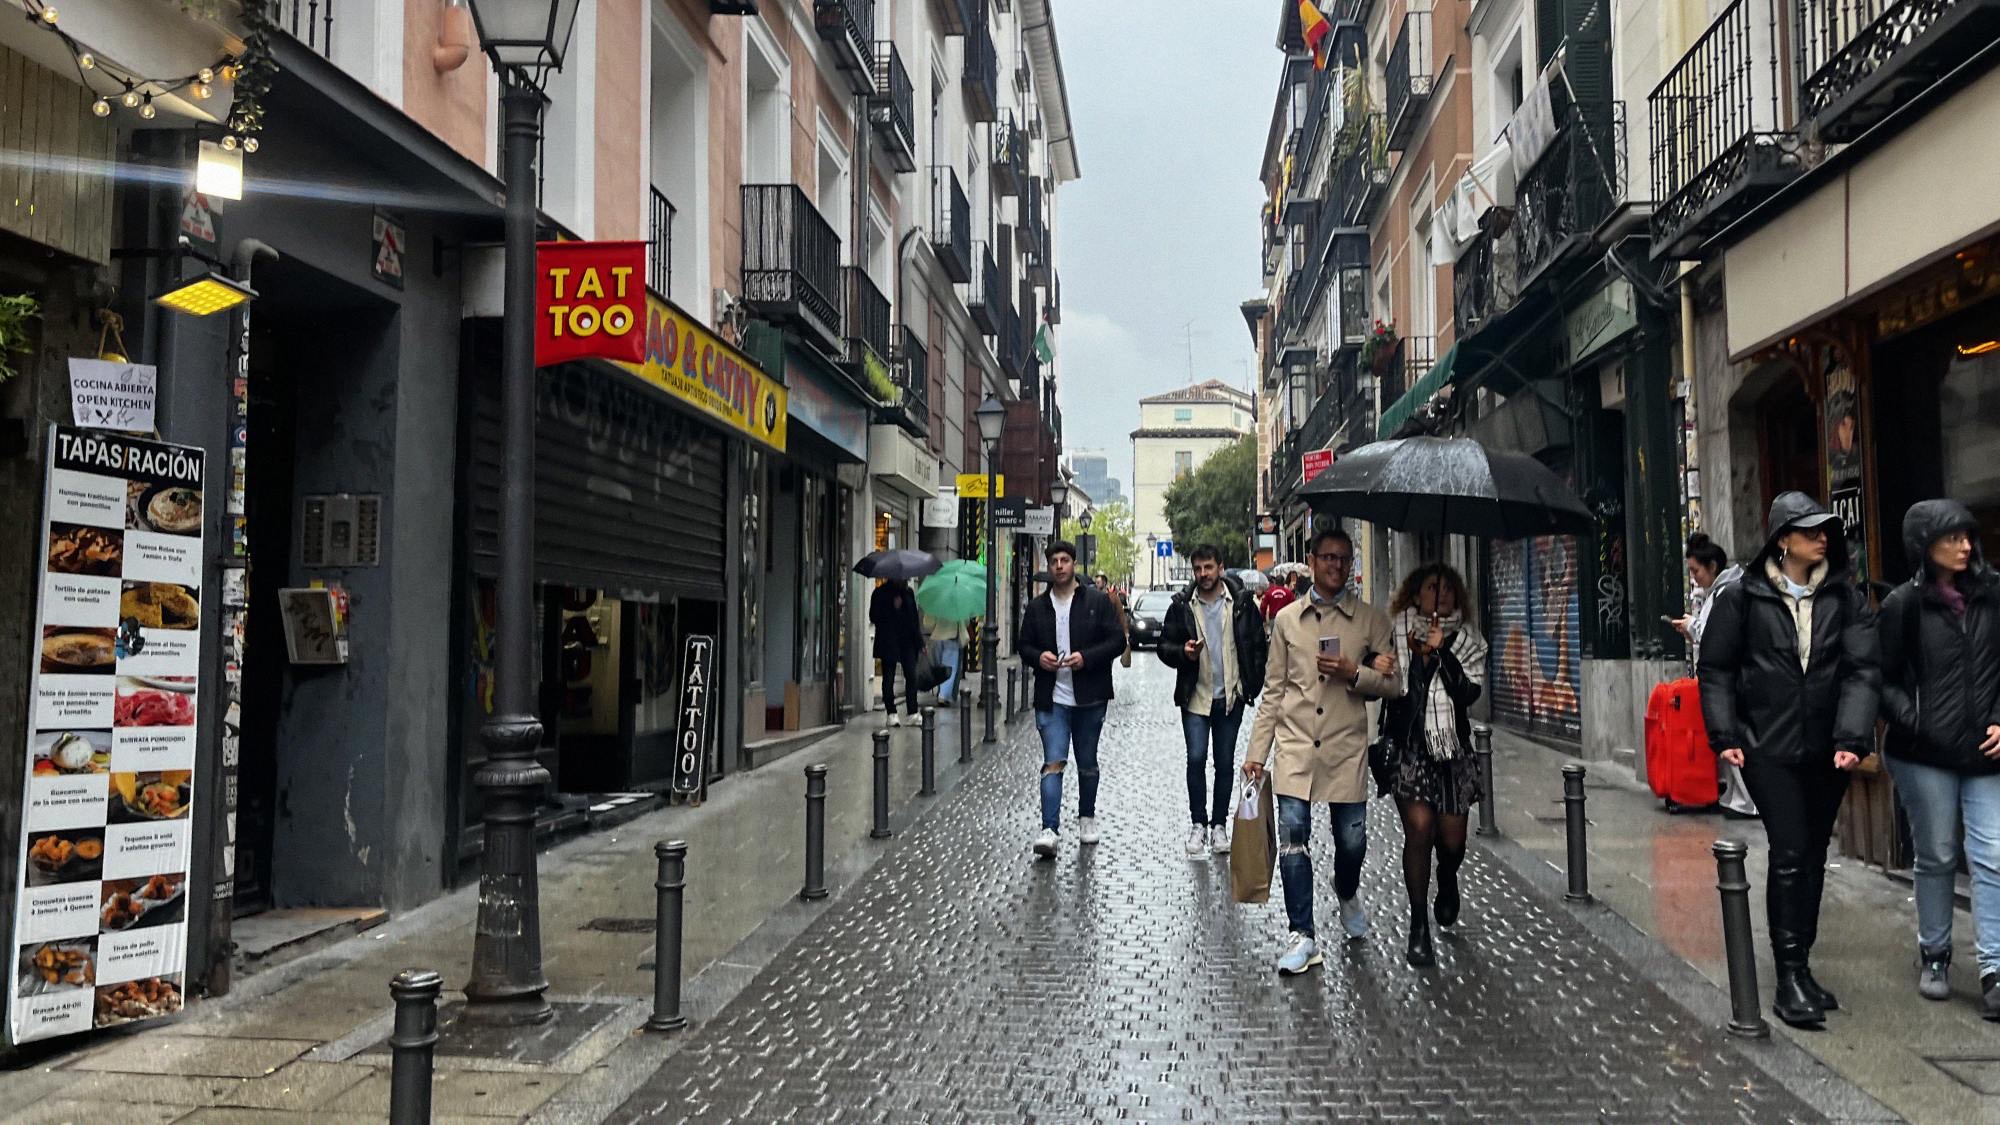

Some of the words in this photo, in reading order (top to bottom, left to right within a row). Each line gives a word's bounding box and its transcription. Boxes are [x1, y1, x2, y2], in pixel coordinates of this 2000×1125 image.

[549, 266, 633, 300] TAT
[548, 304, 634, 337] TOO
[73, 378, 113, 390] COCINA
[114, 382, 155, 395] ABIERTA
[682, 329, 698, 379] &
[701, 343, 762, 428] CATHY
[76, 394, 108, 407] OPEN
[110, 396, 152, 411] KITCHEN
[681, 641, 707, 774] TATTOO
[50, 788, 88, 796] Guacamole
[32, 897, 66, 906] Croquetas
